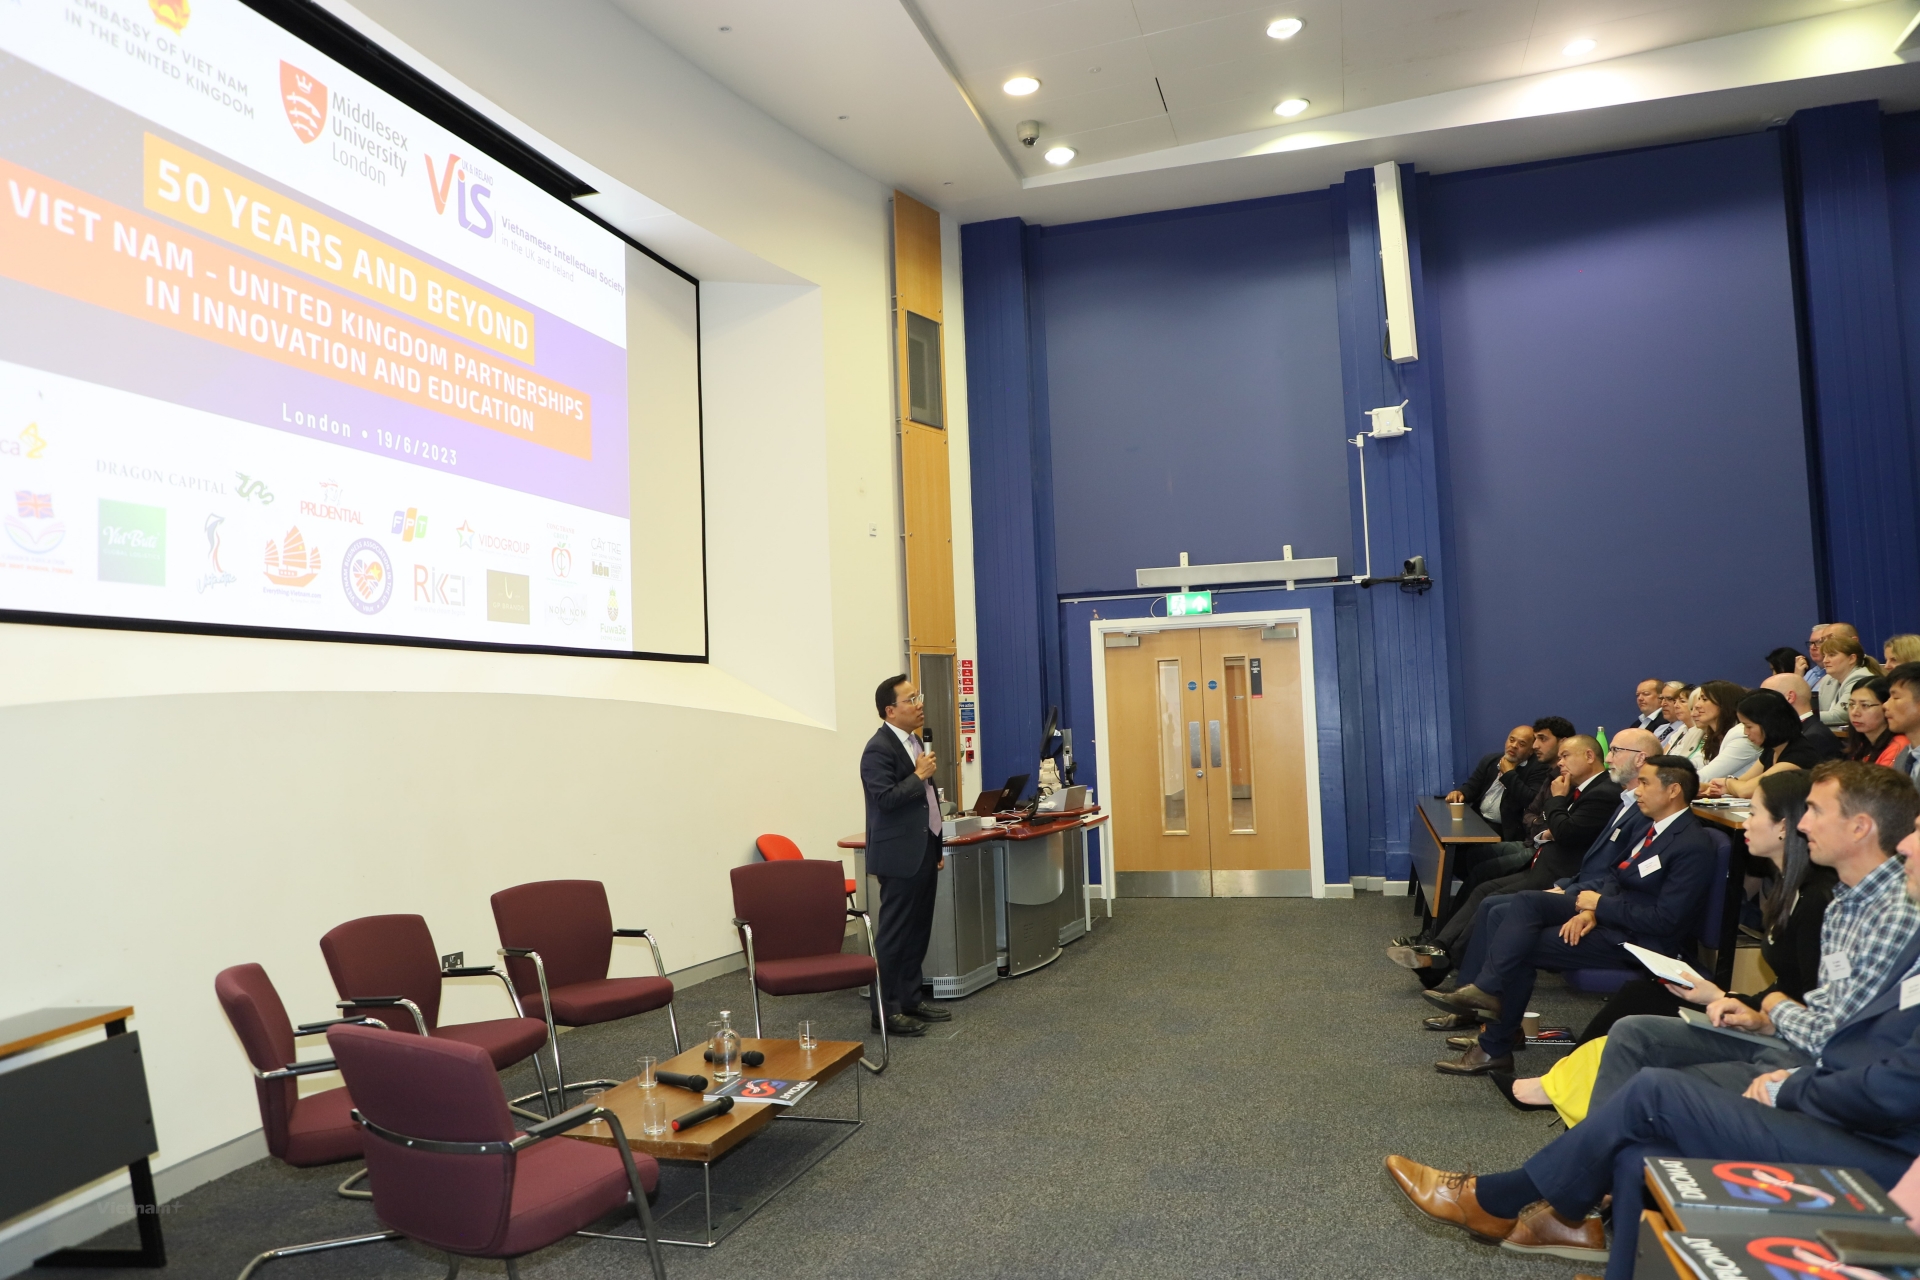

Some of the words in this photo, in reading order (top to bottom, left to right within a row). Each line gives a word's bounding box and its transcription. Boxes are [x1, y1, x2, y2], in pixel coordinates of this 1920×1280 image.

[64, 7, 82, 28] IN
[88, 19, 120, 49] THE
[125, 39, 182, 80] UNITED
[186, 72, 255, 120] KINGDOM
[73, 0, 151, 42] MBASSY
[156, 37, 177, 56] OF
[182, 48, 214, 77] VIET
[217, 69, 248, 97] NAM
[332, 91, 408, 152] Middlesex
[332, 115, 407, 177] University
[332, 142, 386, 187] London
[461, 159, 469, 171] UK
[474, 166, 494, 186] IRELAND
[158, 158, 210, 214] 50
[223, 186, 343, 271] YEARS
[352, 248, 417, 302] AND
[427, 278, 529, 350] BEYOND
[501, 215, 552, 253] Vietnamese
[553, 245, 598, 279] Intellectual
[599, 271, 625, 296] Society
[501, 233, 509, 247] in
[511, 238, 523, 255] the
[525, 246, 535, 262] UK
[537, 254, 550, 269] and
[552, 261, 574, 283] Ireland
[8, 178, 101, 242] VIET
[113, 220, 194, 278] NAM
[228, 264, 332, 328] UNITED
[341, 307, 448, 371] KINGDOM
[454, 351, 584, 421] PARTNERSHIPS
[146, 275, 180, 315] IN
[193, 292, 367, 376] INNOVATION
[374, 357, 421, 394] AND
[428, 376, 534, 432] EDUCATION
[282, 402, 351, 438] London
[377, 429, 457, 466] 19/6/2023
[96, 459, 164, 484] DRAGON
[168, 472, 228, 495] CAPITAL
[300, 500, 364, 526] PRUDENTIAL
[479, 533, 531, 554] VIDOGROUP
[344, 541, 363, 567] BUSINESS
[363, 541, 390, 570] ASSOCIATION
[549, 605, 566, 615] NOM
[570, 608, 586, 618] NOM
